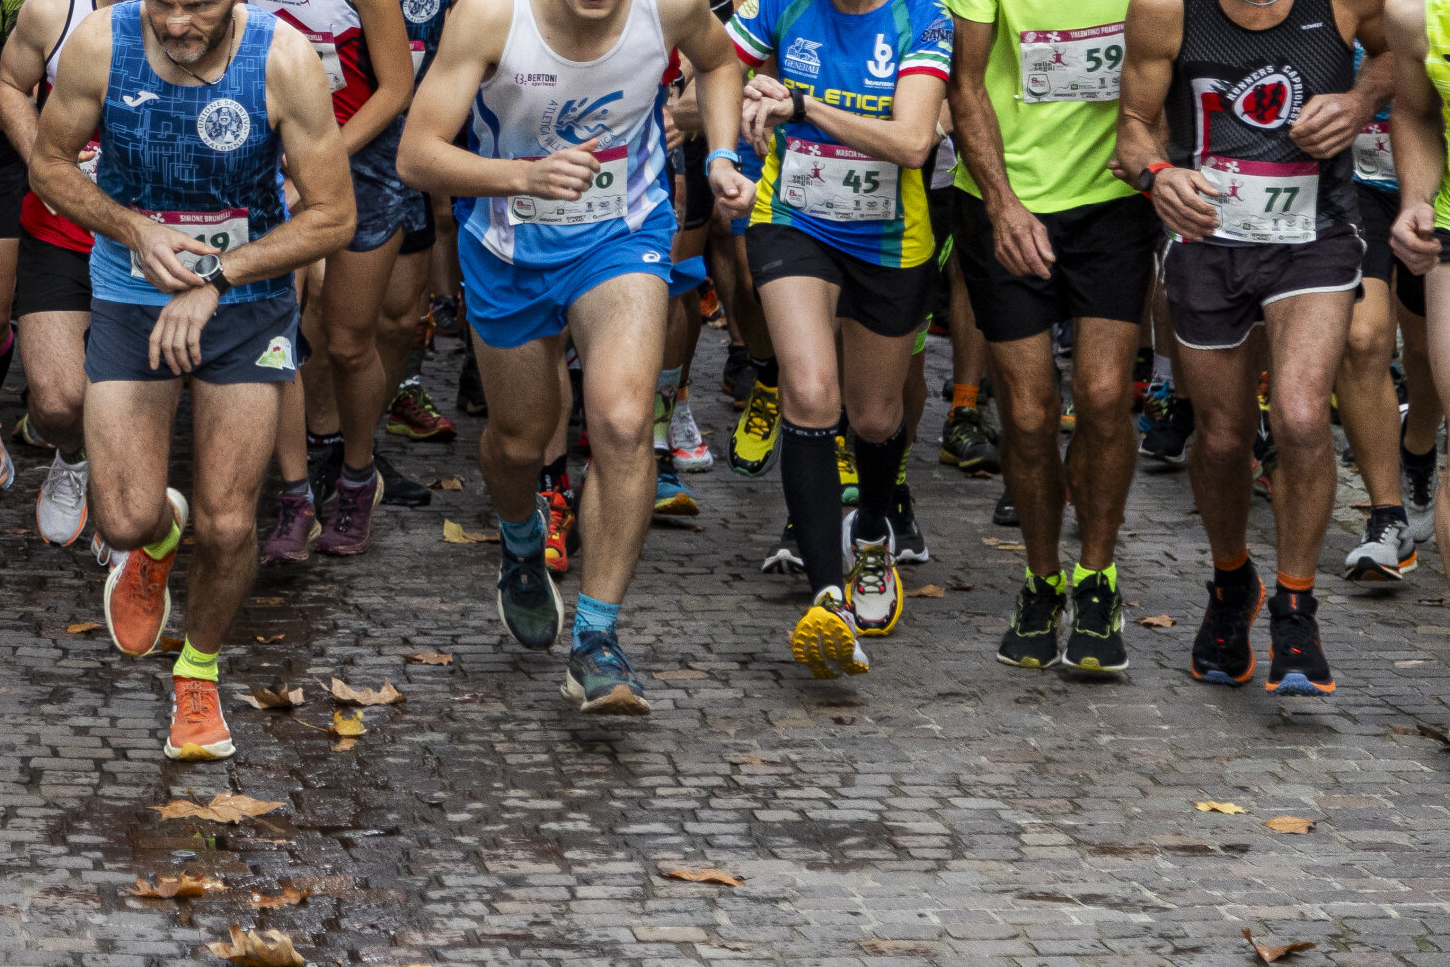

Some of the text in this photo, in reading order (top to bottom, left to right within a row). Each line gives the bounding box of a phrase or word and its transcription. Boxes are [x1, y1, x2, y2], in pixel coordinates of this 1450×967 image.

[1070, 27, 1100, 39] VALENTINO
[784, 58, 821, 75] GENERALI
[1085, 44, 1124, 73] 59
[527, 73, 558, 83] BERTONI
[1226, 64, 1275, 101] RUNNERS
[198, 99, 249, 131] UNIONE SPORTIVA
[540, 99, 559, 136] ATLETICA
[203, 137, 245, 151] MALONNO
[835, 149, 857, 158] MASCIA
[842, 169, 881, 194] 45
[1264, 186, 1300, 213] 77
[179, 211, 233, 223] SIMONE BRUNELLI
